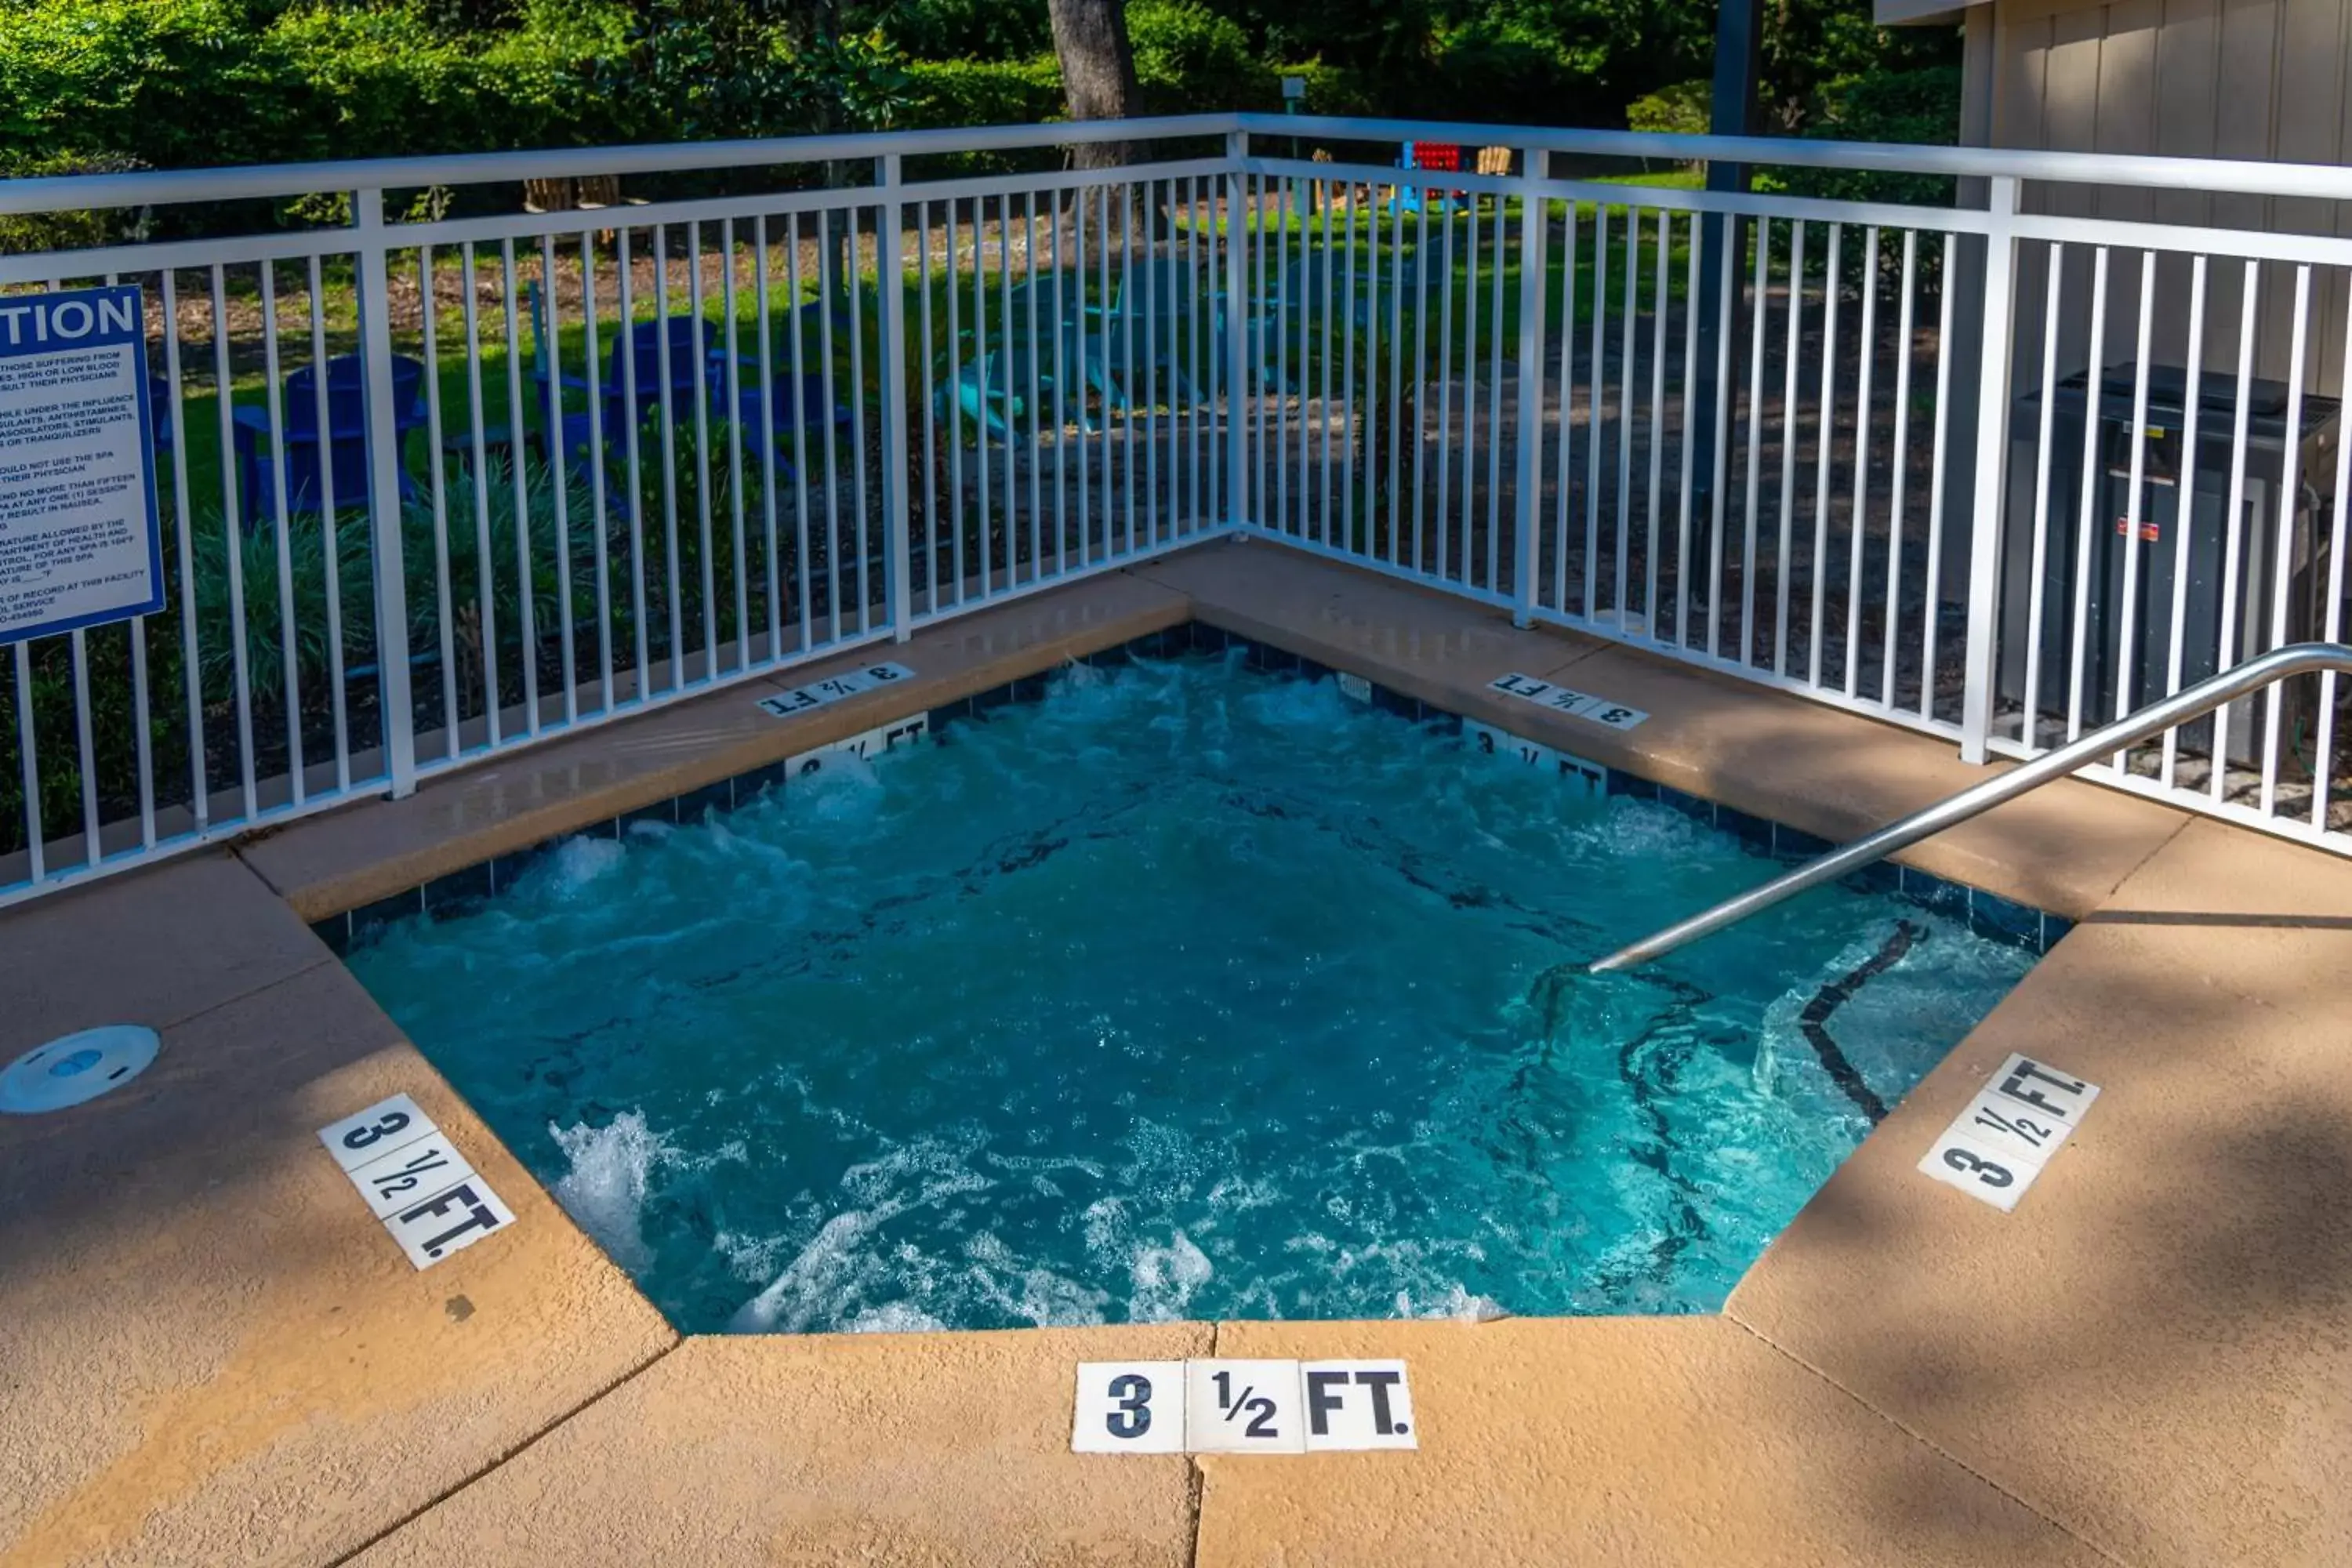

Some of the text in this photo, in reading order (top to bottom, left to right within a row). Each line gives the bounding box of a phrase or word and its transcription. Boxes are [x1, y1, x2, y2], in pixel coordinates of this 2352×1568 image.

[36, 354, 91, 368] SUFFERING
[93, 351, 120, 362] FROM
[18, 368, 42, 379] HIGH
[45, 368, 60, 376] OR
[63, 365, 84, 374] LOW
[86, 361, 120, 371] BLOOD
[29, 377, 58, 388] THEIR
[24, 403, 60, 414] UNDER
[60, 400, 81, 410] THE
[82, 394, 133, 406] INFLUENCE
[6, 437, 22, 447] OR
[29, 459, 49, 469] NOT
[52, 456, 71, 466] USE
[74, 454, 93, 463] THE
[95, 451, 114, 460] SPA
[2, 463, 86, 484] THEIR PHYSICIAN
[20, 488, 35, 497] NO
[37, 484, 67, 495] MORE
[69, 479, 95, 490] THAN
[96, 474, 136, 485] FIFTEEN
[12, 499, 24, 509] AT
[27, 495, 47, 507] ANY
[49, 492, 69, 503] ONE
[86, 484, 128, 495] SESSION
[7, 506, 46, 519] RESULT
[48, 503, 59, 511] IN
[41, 524, 89, 540] ALLOWED
[91, 522, 104, 531] BY
[107, 518, 125, 528] THE
[53, 538, 66, 547] OF
[68, 532, 106, 545] HEALTH
[108, 528, 127, 537] AND
[34, 550, 55, 559] FOR
[56, 546, 76, 556] ANY
[79, 543, 97, 552] SPA
[100, 539, 108, 548] IS
[34, 560, 48, 569] OF
[52, 555, 72, 566] THIS
[75, 551, 94, 563] SPA
[6, 594, 20, 603] OF
[23, 585, 65, 599] RECORD
[67, 582, 78, 590] AT
[82, 578, 103, 588] THIS
[104, 569, 144, 584] FACILITY
[12, 574, 21, 583] IS
[13, 596, 56, 611] SERVICE
[868, 667, 899, 681] 3
[1600, 708, 1633, 724] 3
[1944, 1148, 2014, 1188] 3
[2000, 1060, 2085, 1117] FT.
[343, 1112, 410, 1149] 3
[399, 1183, 500, 1258] FT.
[1106, 1374, 1152, 1439] 3
[1307, 1371, 1409, 1435] FT.
